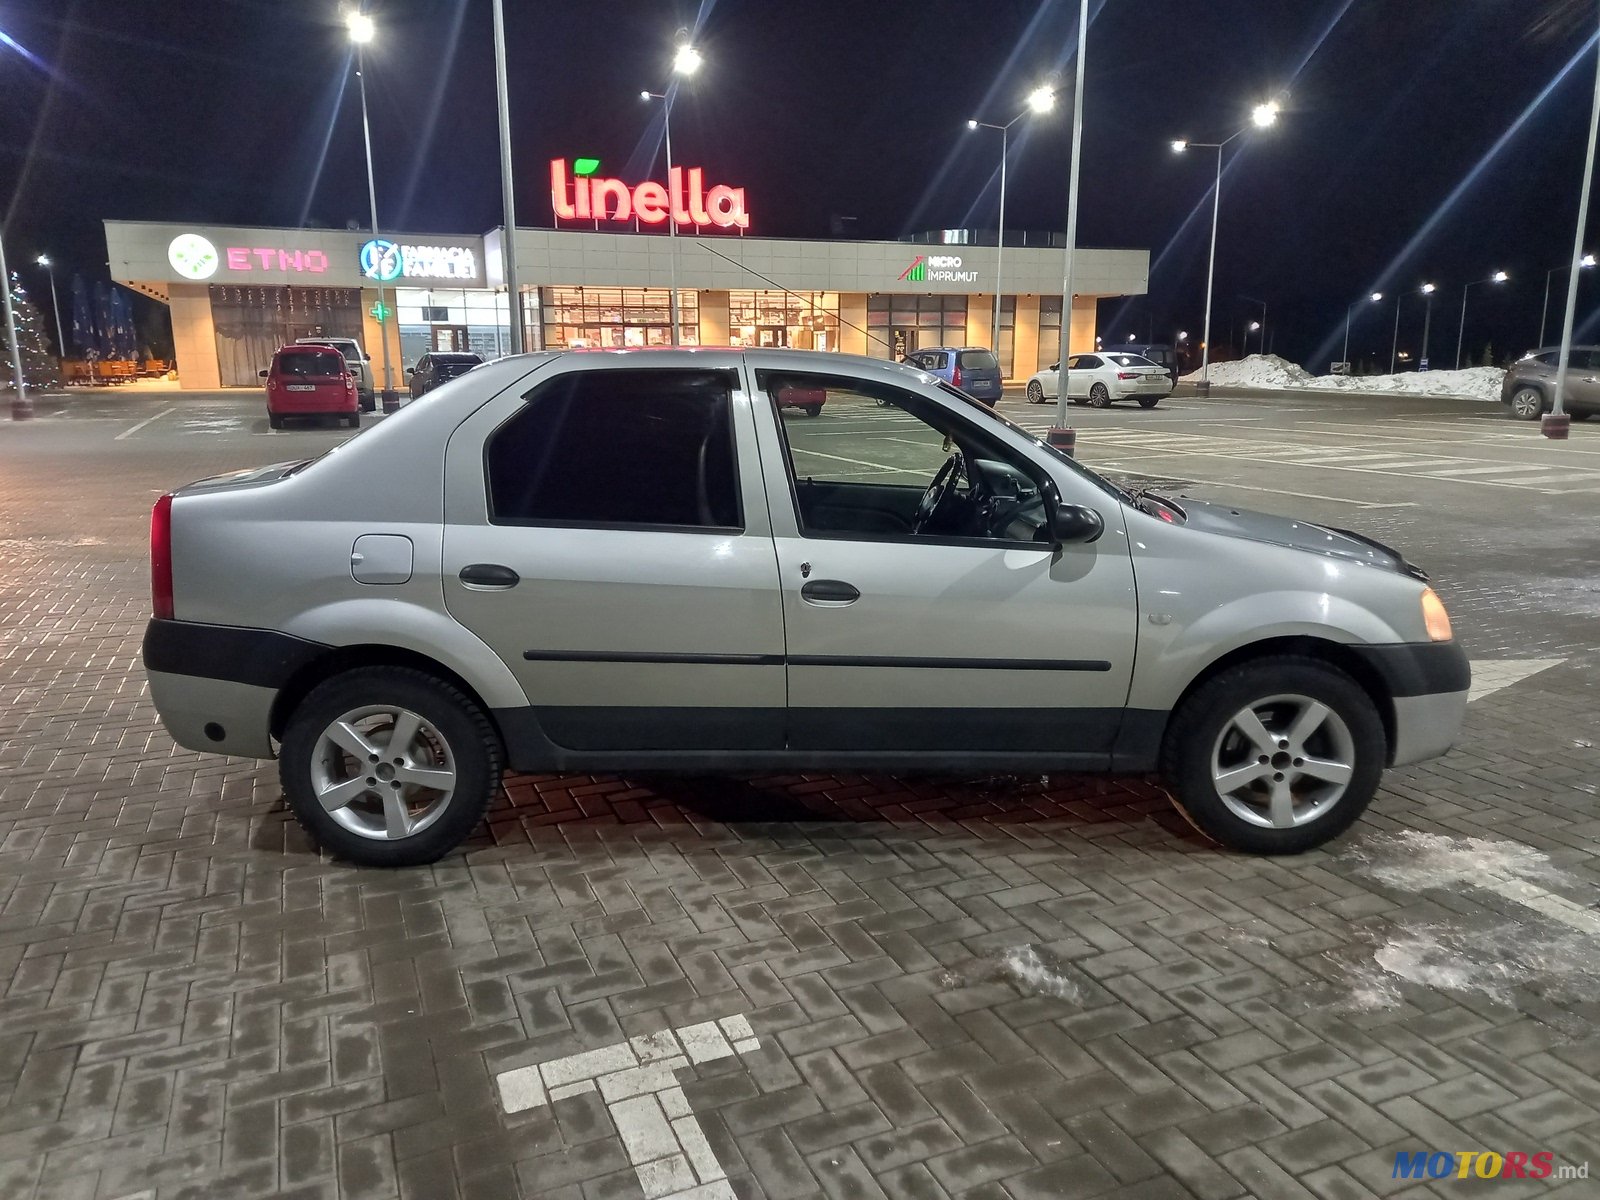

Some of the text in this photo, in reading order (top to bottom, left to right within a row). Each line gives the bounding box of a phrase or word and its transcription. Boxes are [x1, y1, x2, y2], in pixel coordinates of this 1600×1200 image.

[551, 157, 749, 228] linella
[226, 247, 329, 273] ETNO
[401, 245, 474, 261] FARMACIA
[928, 256, 962, 268] MICRO
